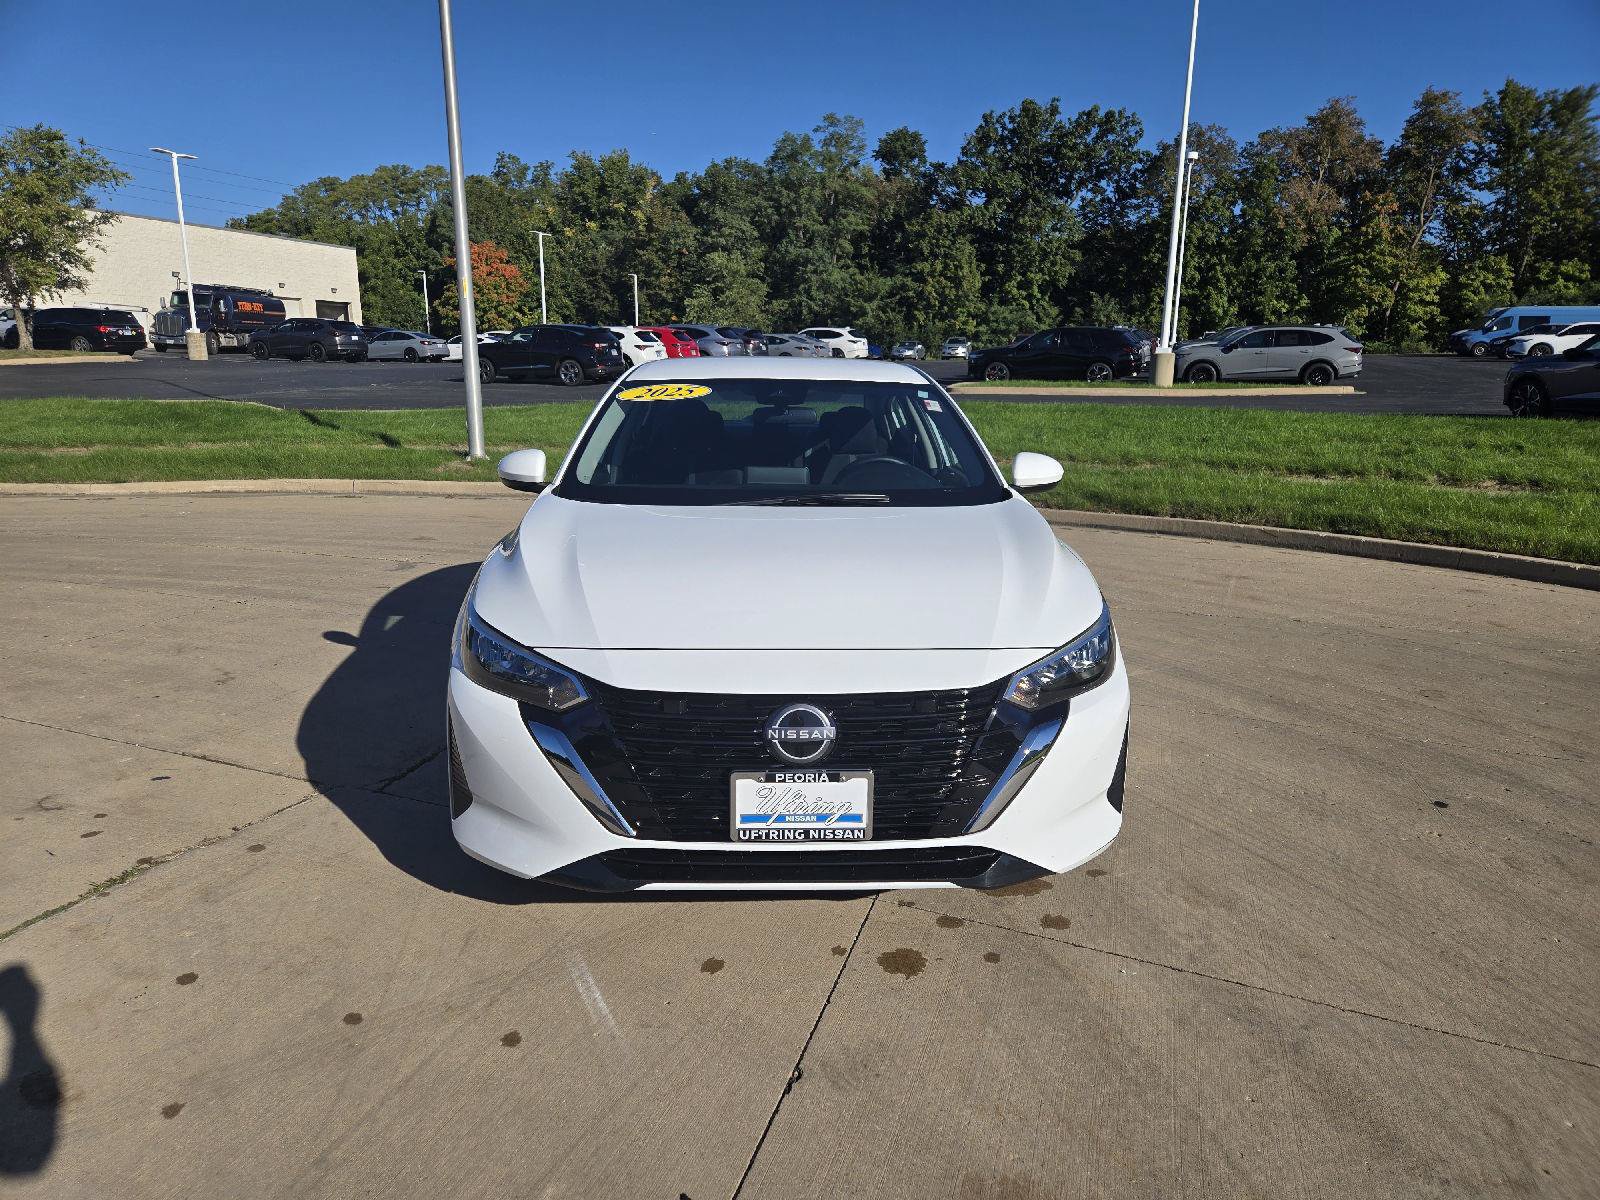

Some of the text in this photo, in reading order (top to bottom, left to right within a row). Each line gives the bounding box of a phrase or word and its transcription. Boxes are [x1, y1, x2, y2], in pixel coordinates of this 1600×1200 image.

[633, 386, 695, 399] 2025
[768, 729, 835, 739] NISSAN
[775, 773, 829, 783] PEORIA
[739, 829, 864, 840] UFTRING NISSAN
